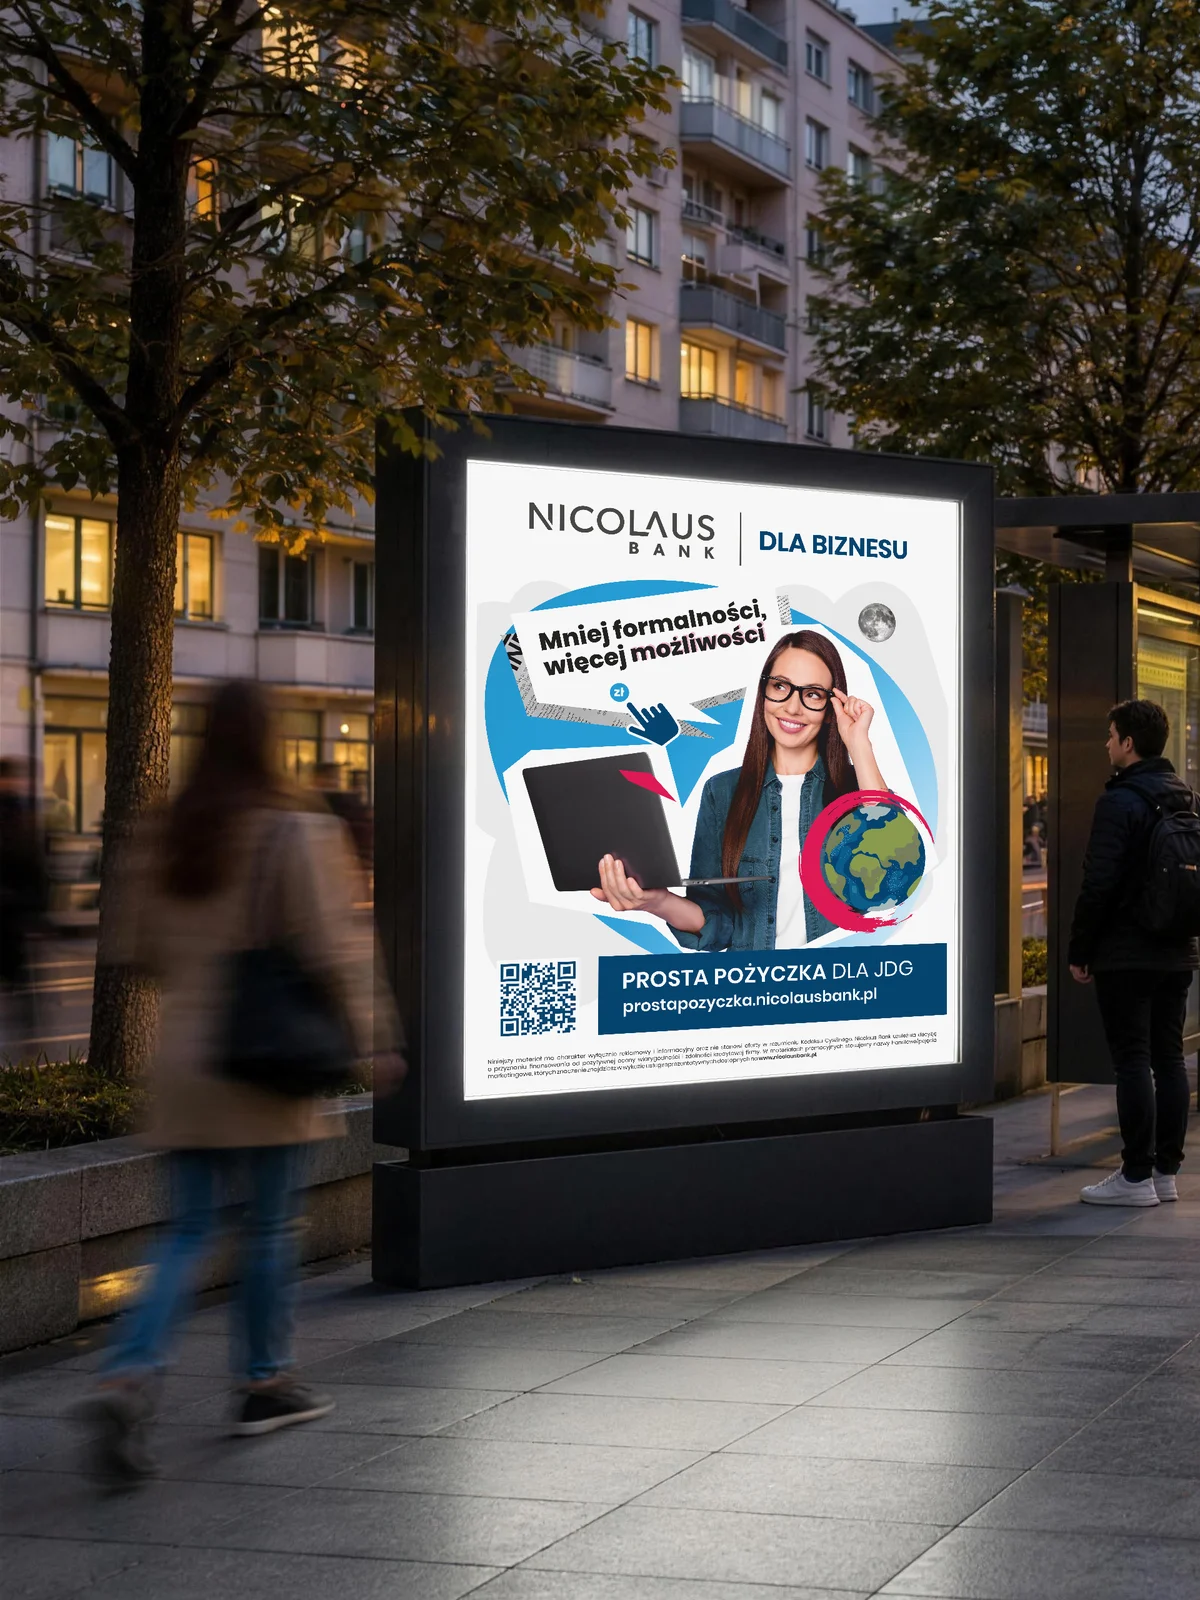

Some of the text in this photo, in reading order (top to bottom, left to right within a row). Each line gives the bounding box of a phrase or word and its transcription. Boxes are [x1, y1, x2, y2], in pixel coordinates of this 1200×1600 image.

[528, 502, 715, 541] NICOLAUS
[629, 541, 714, 560] BANK
[759, 531, 908, 560] DLA BIZNESU
[538, 621, 610, 651] Mniej
[613, 598, 767, 640] formalności,
[543, 622, 766, 676] więcej możliwości
[613, 686, 625, 698] zł
[622, 960, 913, 989] PROSTA POŻYCZKA DLA JDG
[622, 987, 877, 1017] prostapozyczka.nicolausbank.pl
